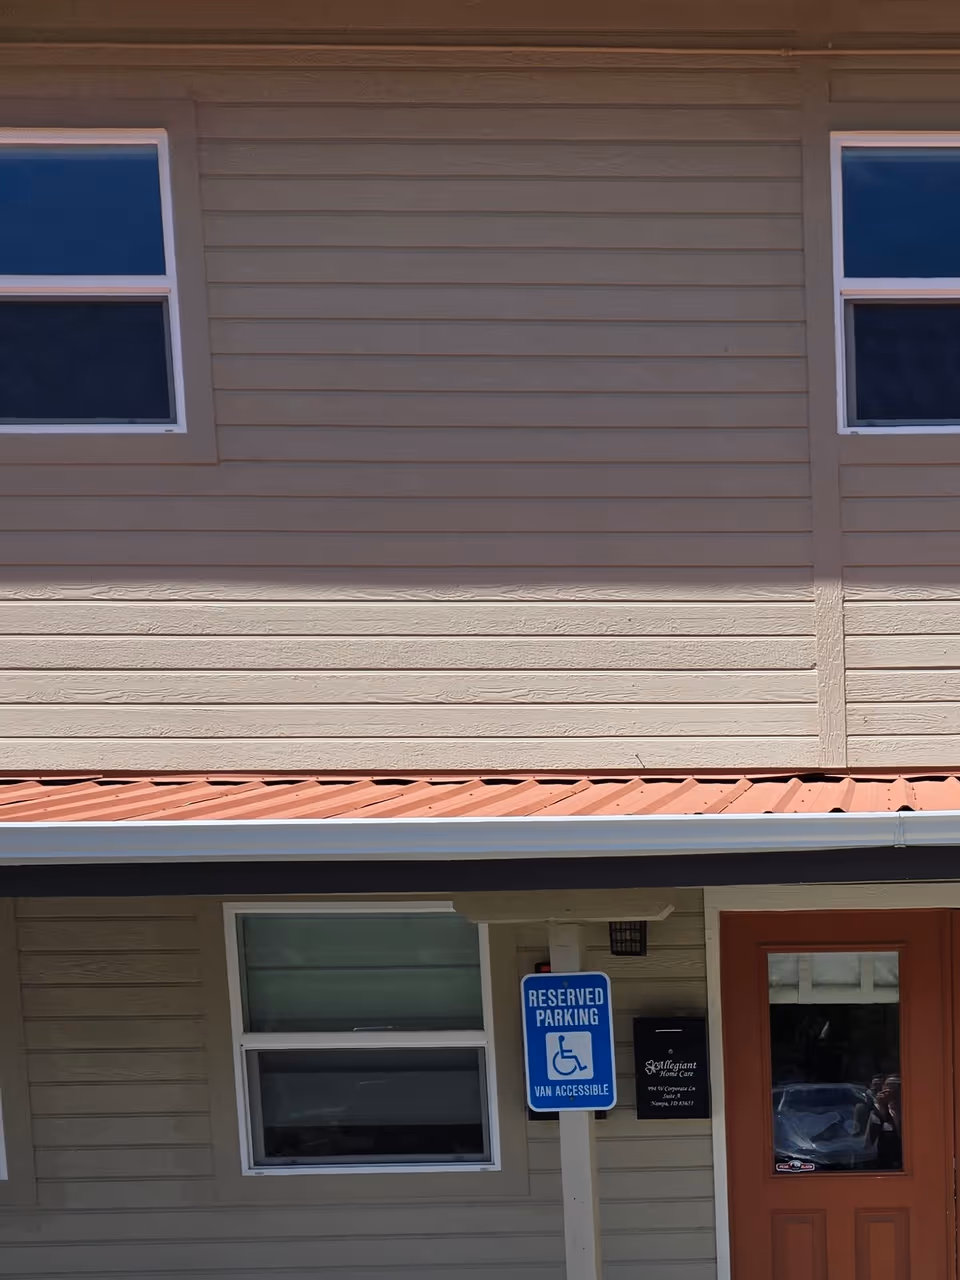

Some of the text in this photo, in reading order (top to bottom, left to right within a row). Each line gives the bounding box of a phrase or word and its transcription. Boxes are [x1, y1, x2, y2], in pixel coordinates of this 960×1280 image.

[528, 987, 604, 1007] RESERVED
[536, 1008, 599, 1027] PARKING
[657, 1060, 697, 1072] Allegiant
[534, 1083, 609, 1097] VAN ACCESSIBLE
